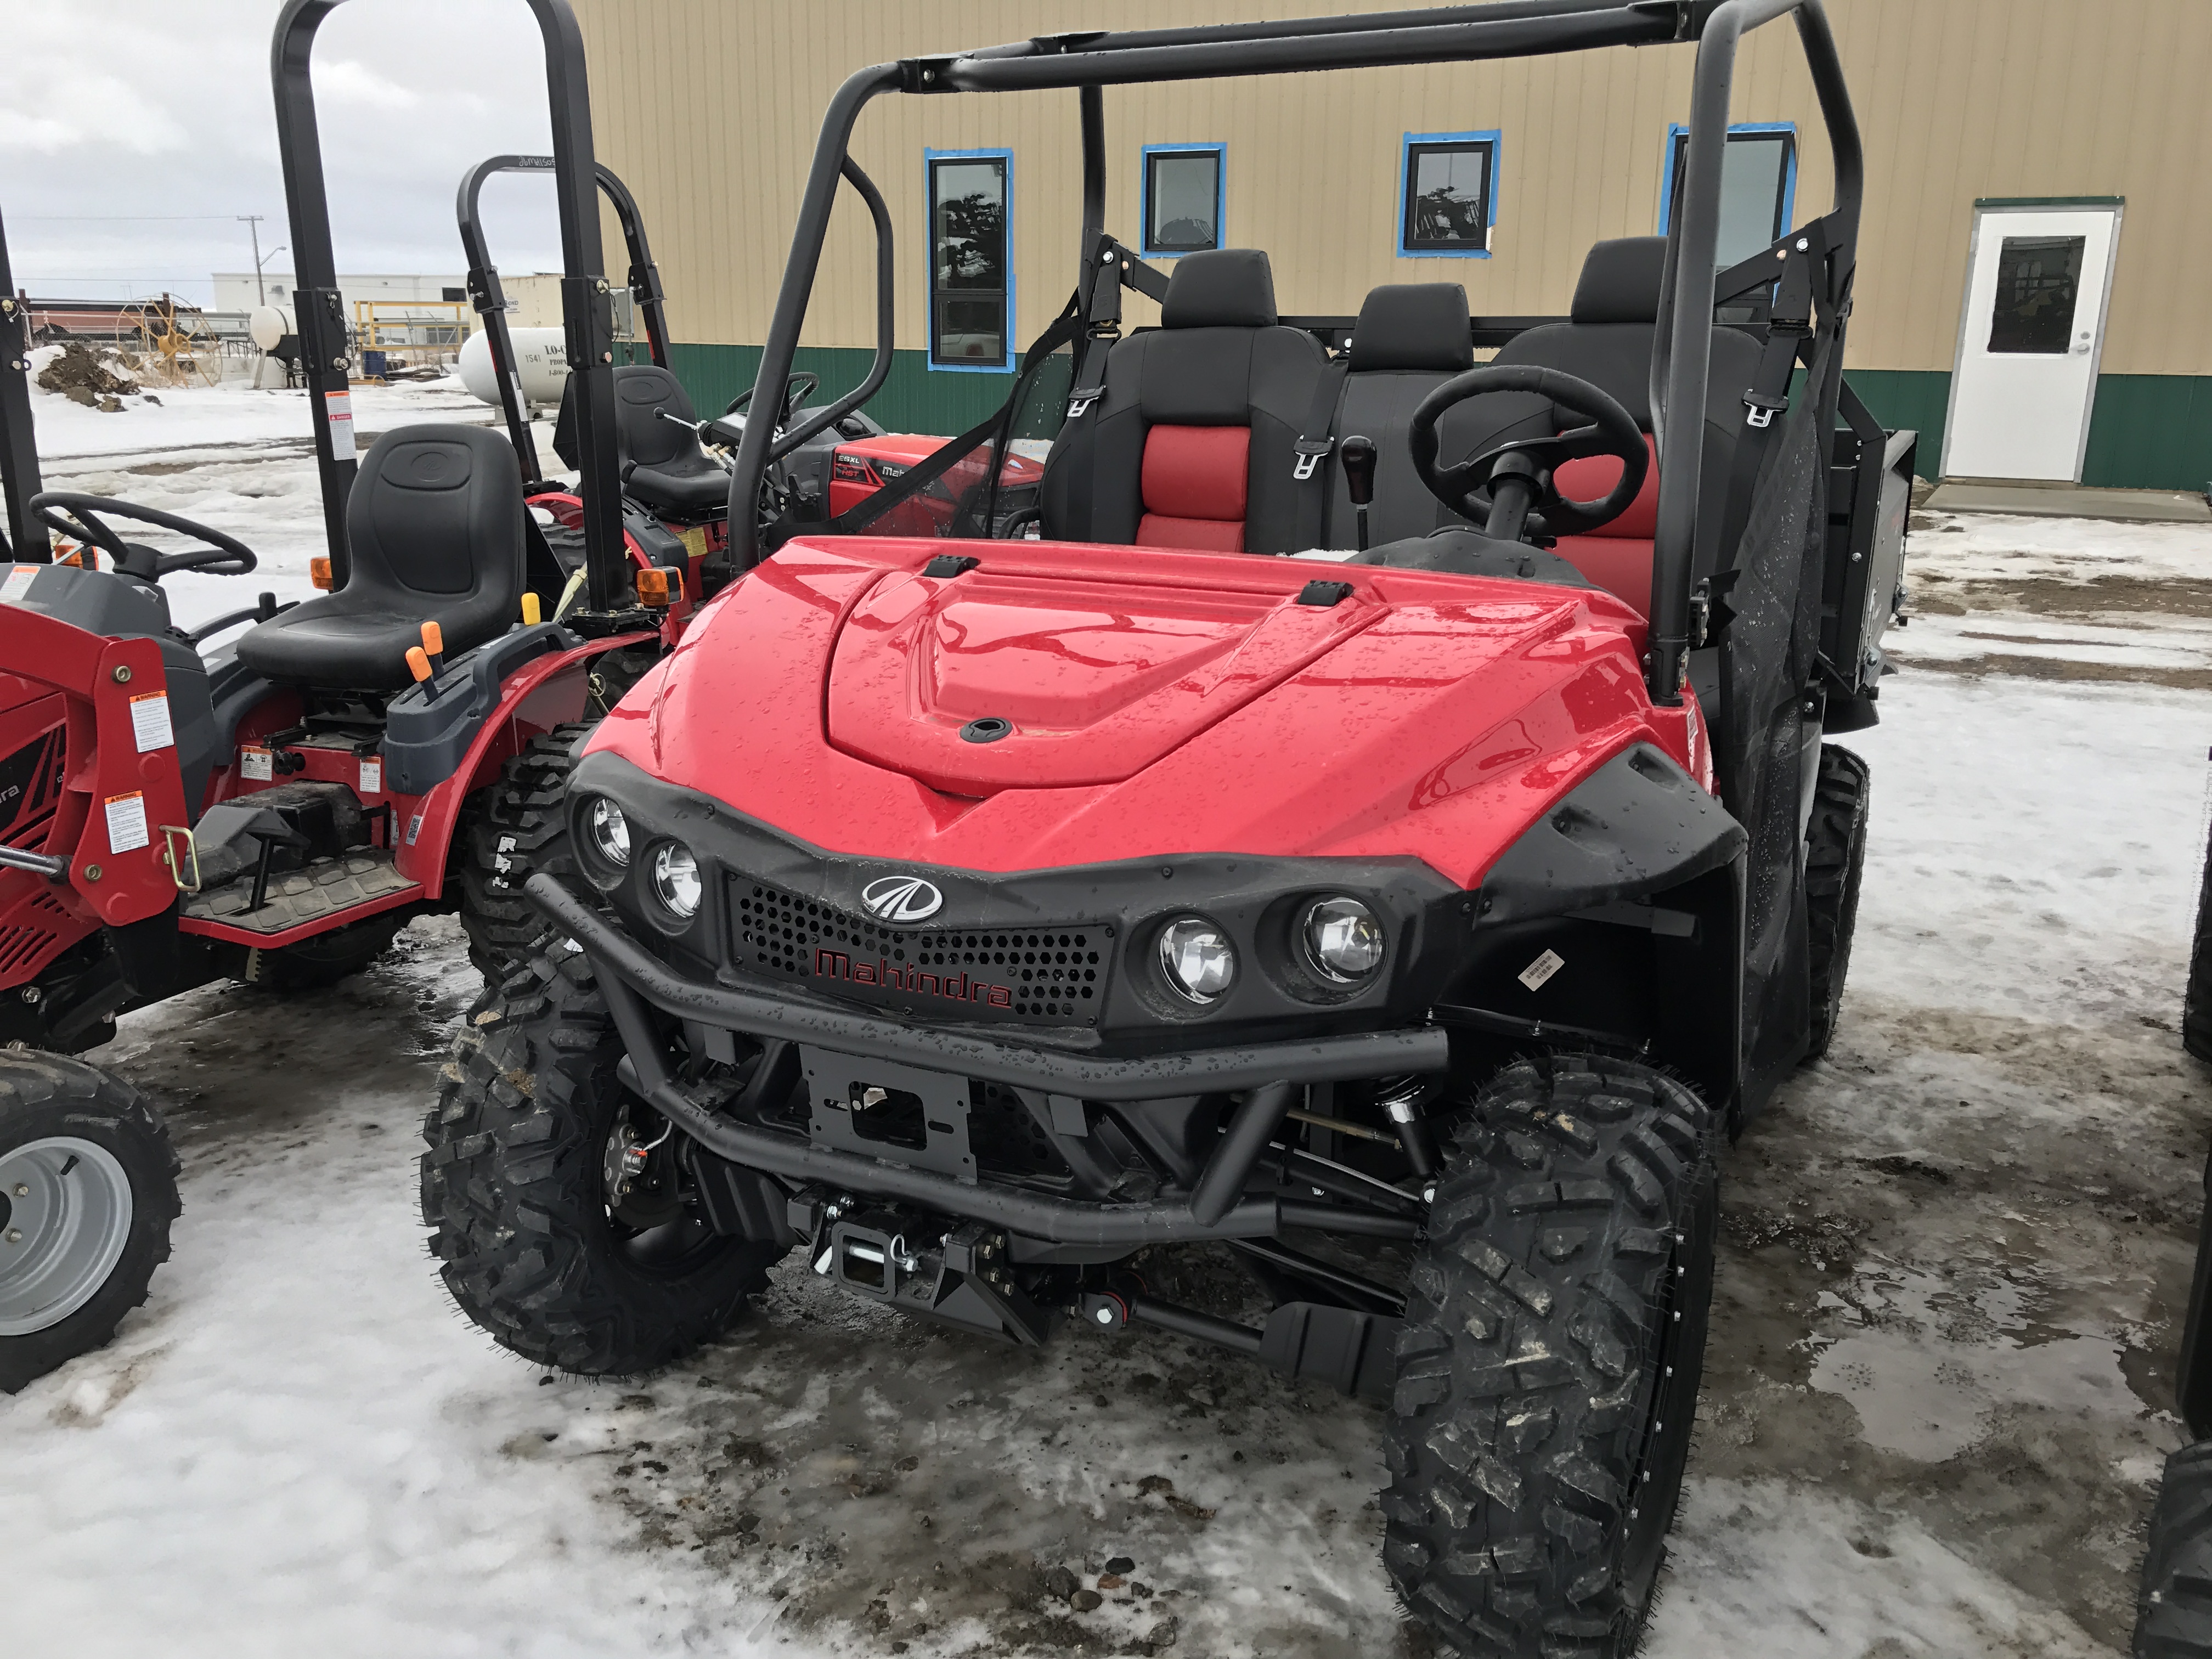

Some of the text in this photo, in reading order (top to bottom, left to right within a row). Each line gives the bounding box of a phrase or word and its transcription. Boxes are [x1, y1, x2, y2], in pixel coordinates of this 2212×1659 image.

[525, 354, 541, 363] 1541
[140, 692, 161, 701] WARNING
[115, 792, 137, 800] WARNING
[815, 947, 1012, 1009] Mahindra
